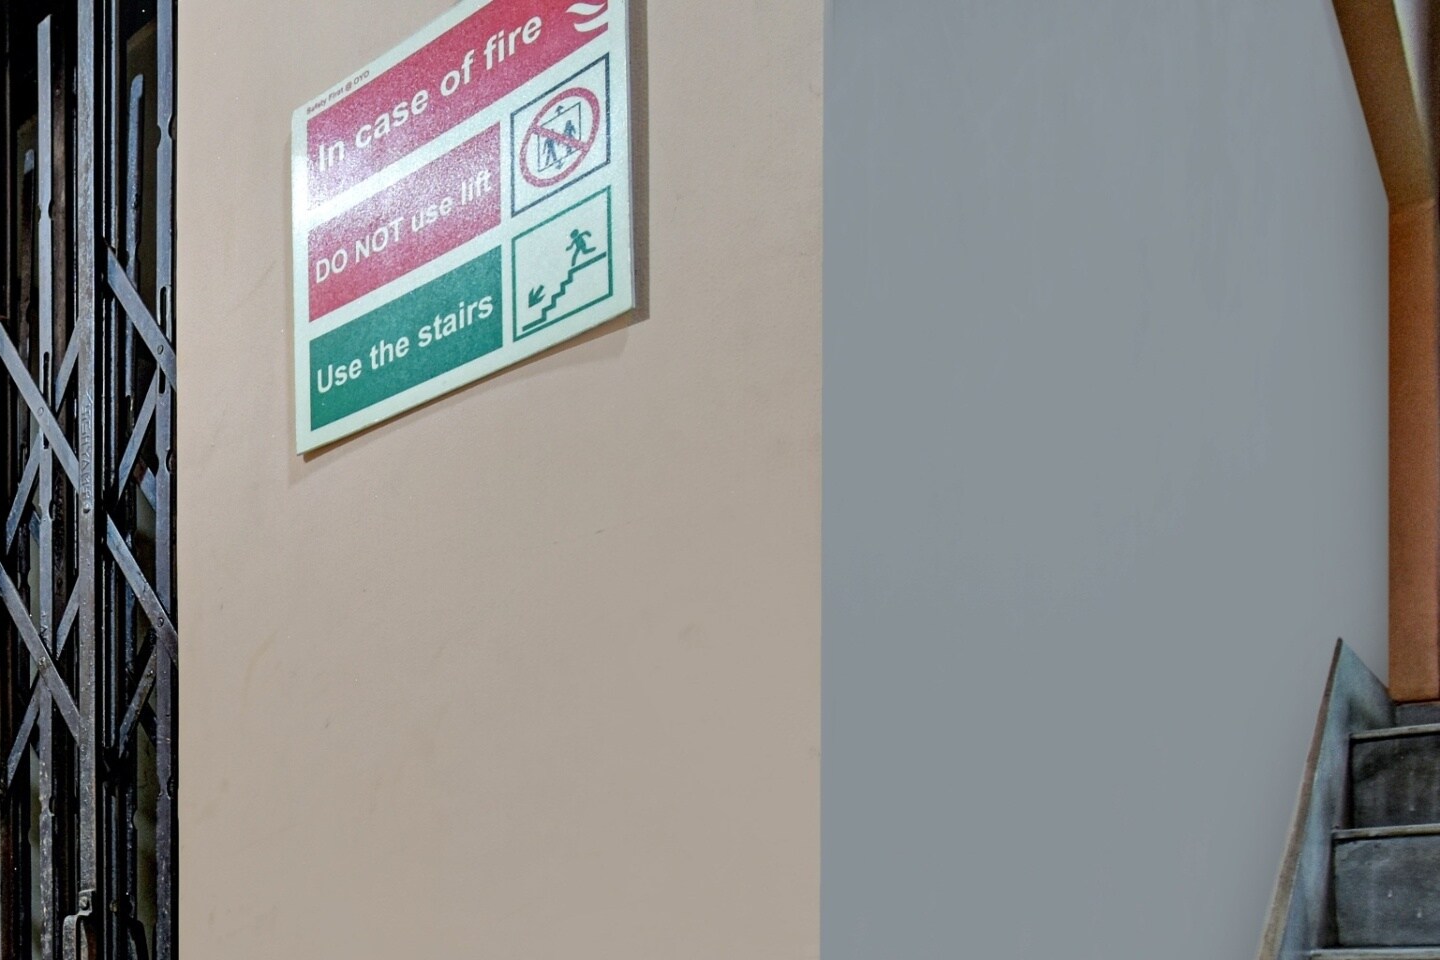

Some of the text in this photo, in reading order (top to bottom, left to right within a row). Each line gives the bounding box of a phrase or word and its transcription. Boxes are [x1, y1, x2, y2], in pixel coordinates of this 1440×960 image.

[306, 70, 370, 115] Safety First @ OYO
[317, 16, 543, 173] In case of fire
[316, 168, 493, 284] DO NOT use lift
[317, 295, 494, 394] Use the stairs
